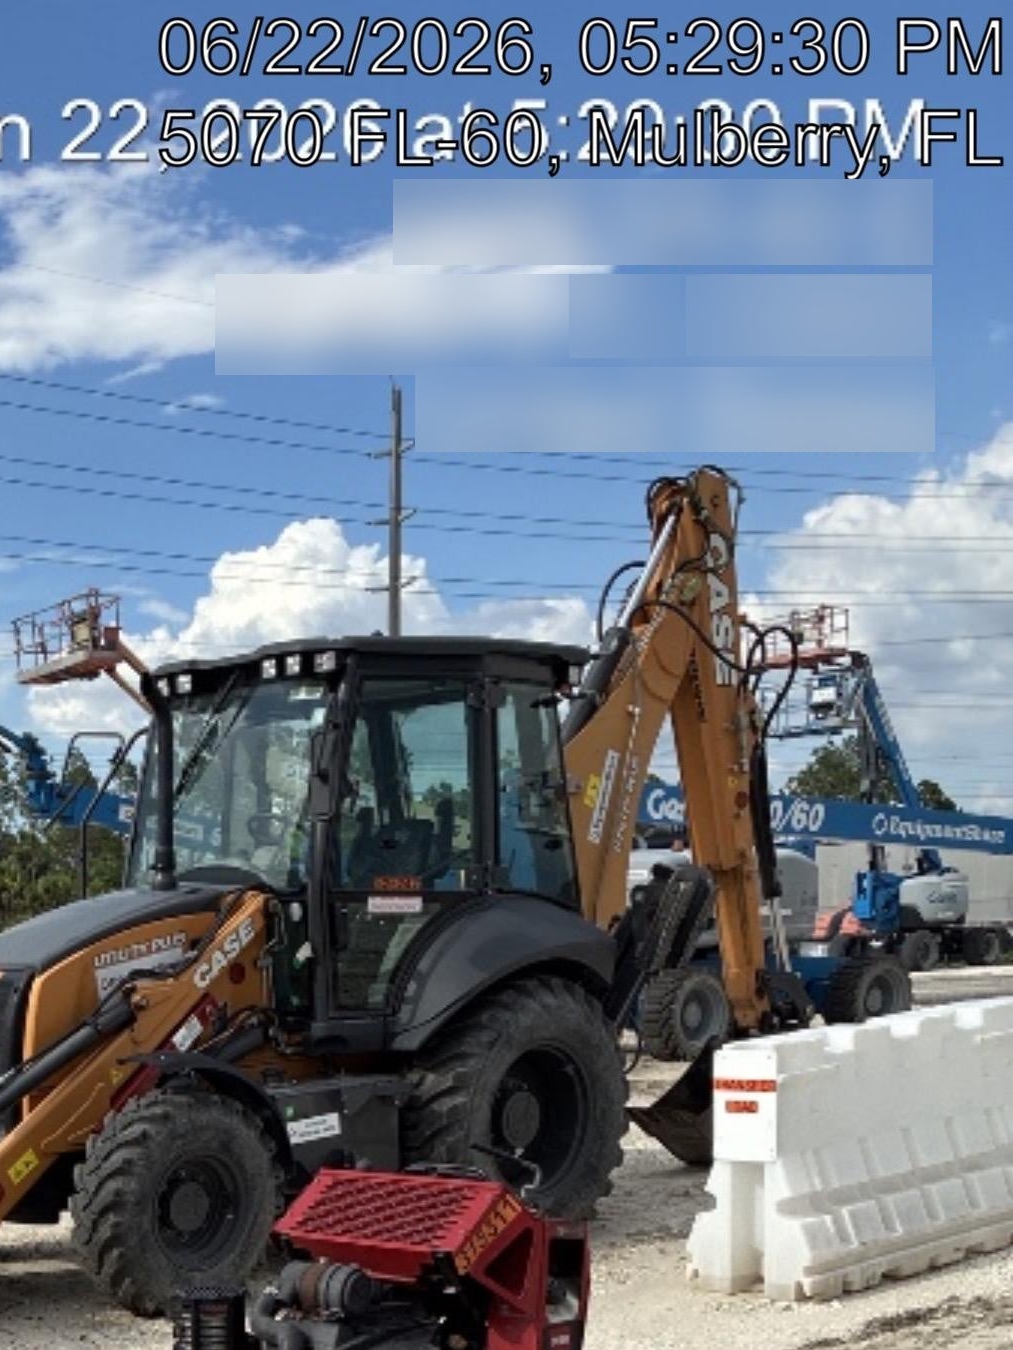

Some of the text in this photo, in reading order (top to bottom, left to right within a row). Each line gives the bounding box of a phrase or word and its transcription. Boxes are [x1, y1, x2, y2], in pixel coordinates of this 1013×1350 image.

[705, 533, 736, 686] CASE
[769, 798, 826, 832] 0/60
[193, 917, 256, 989] CASE
